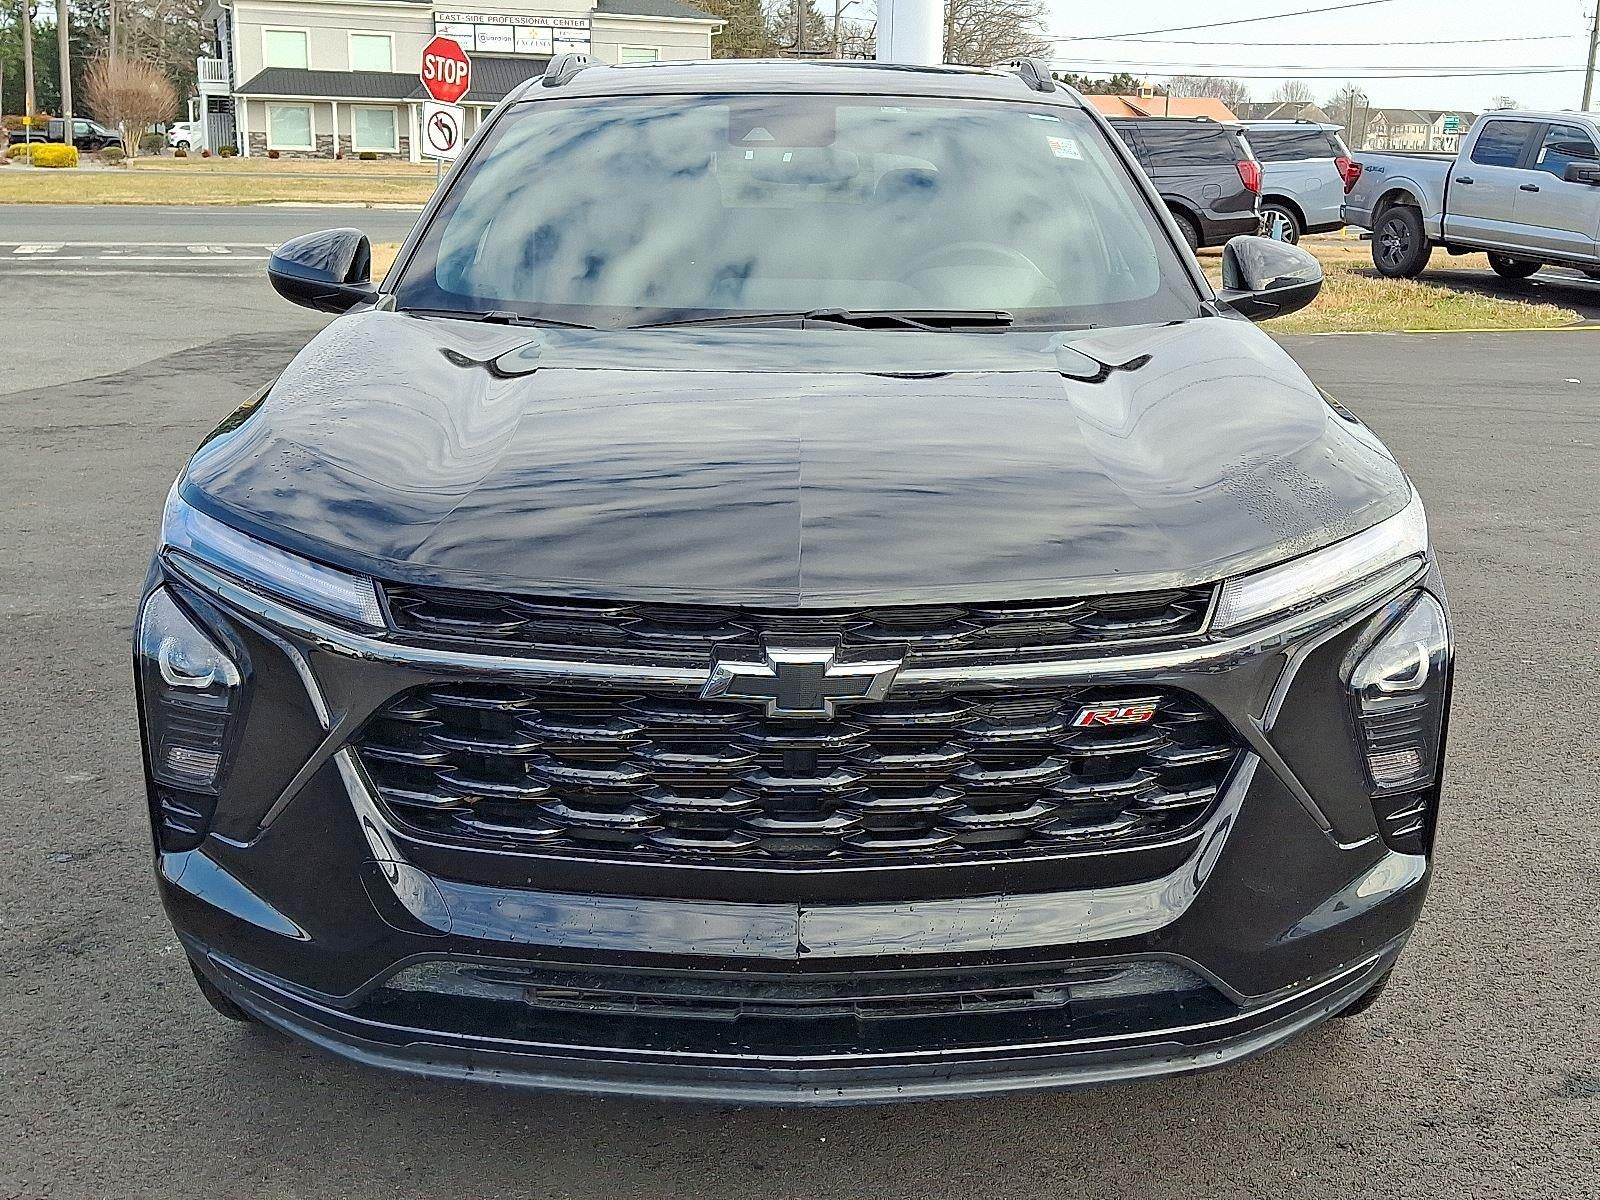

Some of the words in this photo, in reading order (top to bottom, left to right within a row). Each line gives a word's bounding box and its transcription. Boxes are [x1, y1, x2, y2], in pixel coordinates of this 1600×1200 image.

[439, 13, 484, 23] EAST-SIDE
[487, 15, 550, 25] PROFESSIONAL
[553, 19, 585, 27] CENTER
[424, 53, 468, 86] STOP
[1072, 704, 1157, 726] RS
